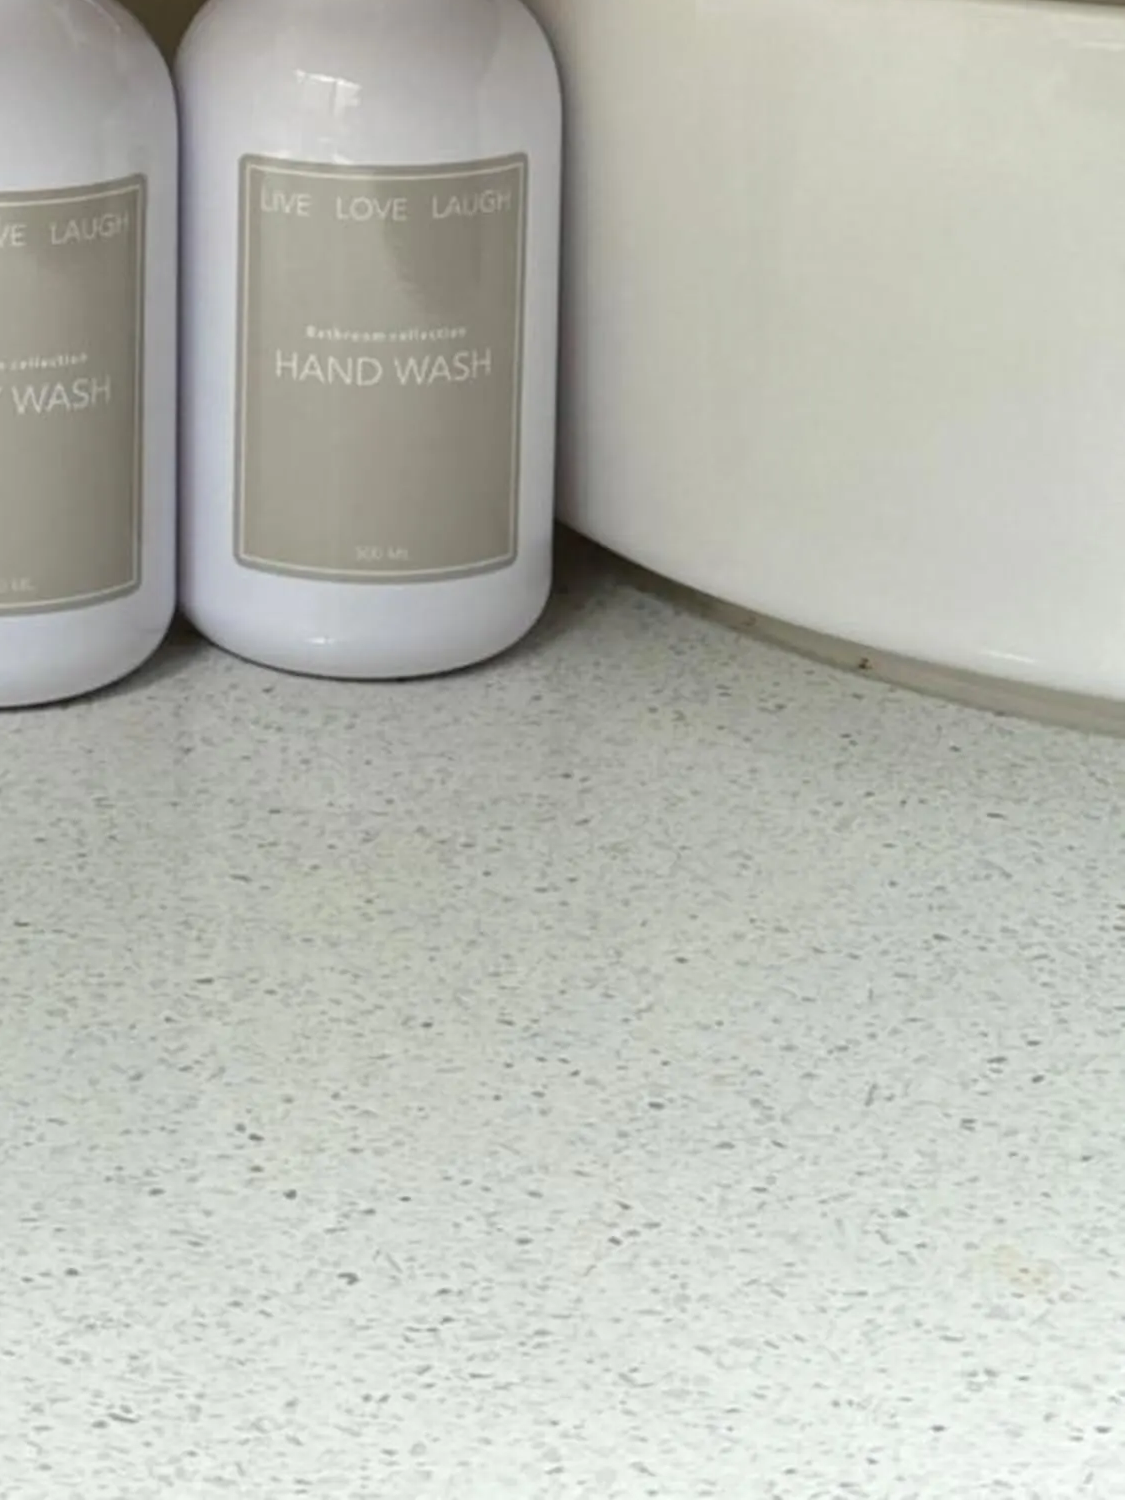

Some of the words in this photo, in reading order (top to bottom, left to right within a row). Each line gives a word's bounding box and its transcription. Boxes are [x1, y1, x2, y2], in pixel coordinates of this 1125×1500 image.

[259, 183, 311, 218] LIVE
[335, 195, 408, 221] LOVE
[432, 188, 512, 219] LAUGH
[50, 213, 129, 245] LAUGH
[275, 348, 382, 387] HAND
[393, 348, 493, 387] WASH
[11, 376, 112, 414] WASH
